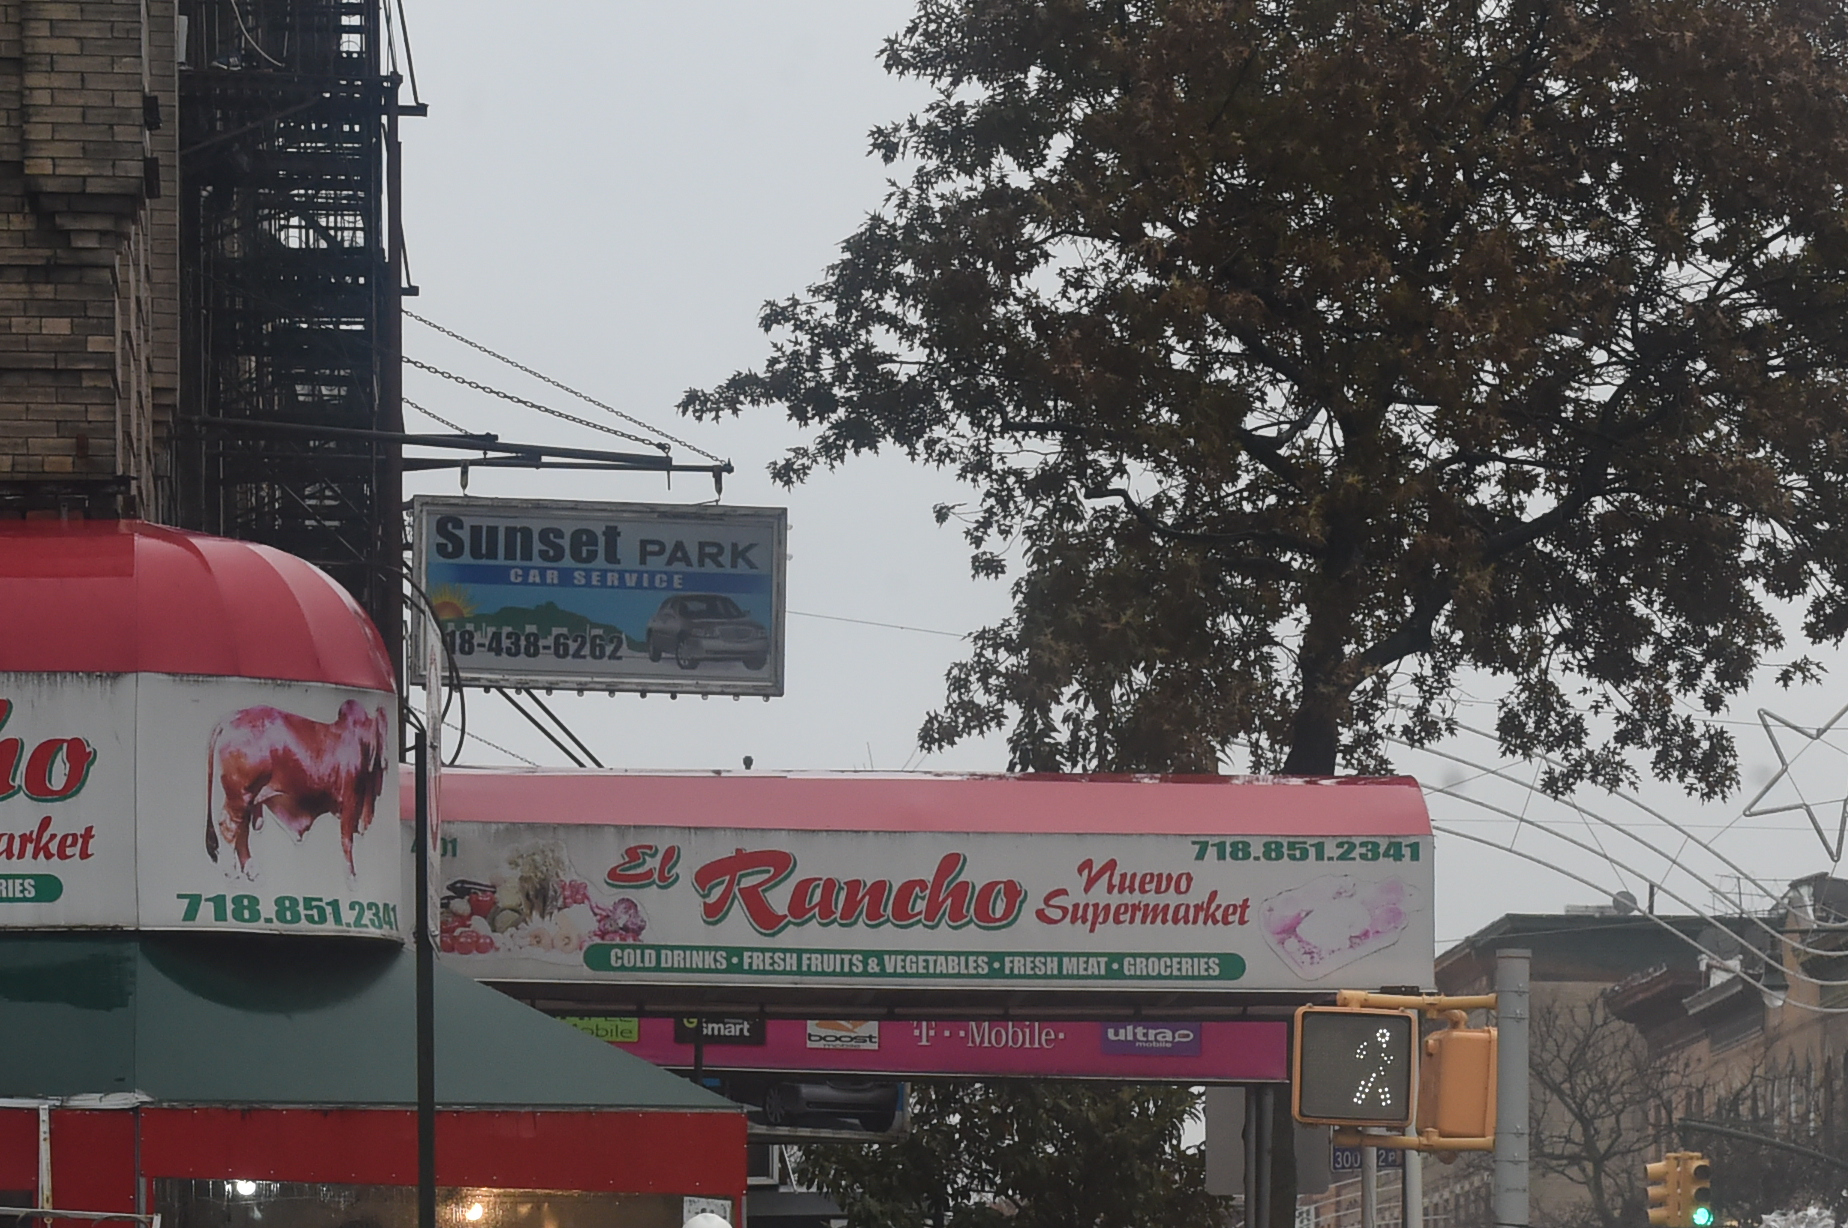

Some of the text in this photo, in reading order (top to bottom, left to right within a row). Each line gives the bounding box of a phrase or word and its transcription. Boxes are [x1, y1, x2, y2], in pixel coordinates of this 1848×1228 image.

[435, 515, 759, 570] Sunset PARK
[510, 567, 684, 589] CAR SERVICE
[445, 628, 625, 661] 18-438-6262
[1190, 840, 1422, 863] 718.851.2341
[603, 843, 1028, 937] El Rancho
[1076, 857, 1194, 896] Nuevo
[176, 892, 399, 932] 718.851.2341
[1034, 888, 1251, 934] Supermarket
[610, 947, 1220, 977] COLD DRINKS FRESH FRUITS & VEGETABLES FRESH MEAT GROCERIES
[807, 1032, 878, 1045] boost
[1135, 1041, 1173, 1049] mobile
[1335, 1150, 1387, 1169] 3002
